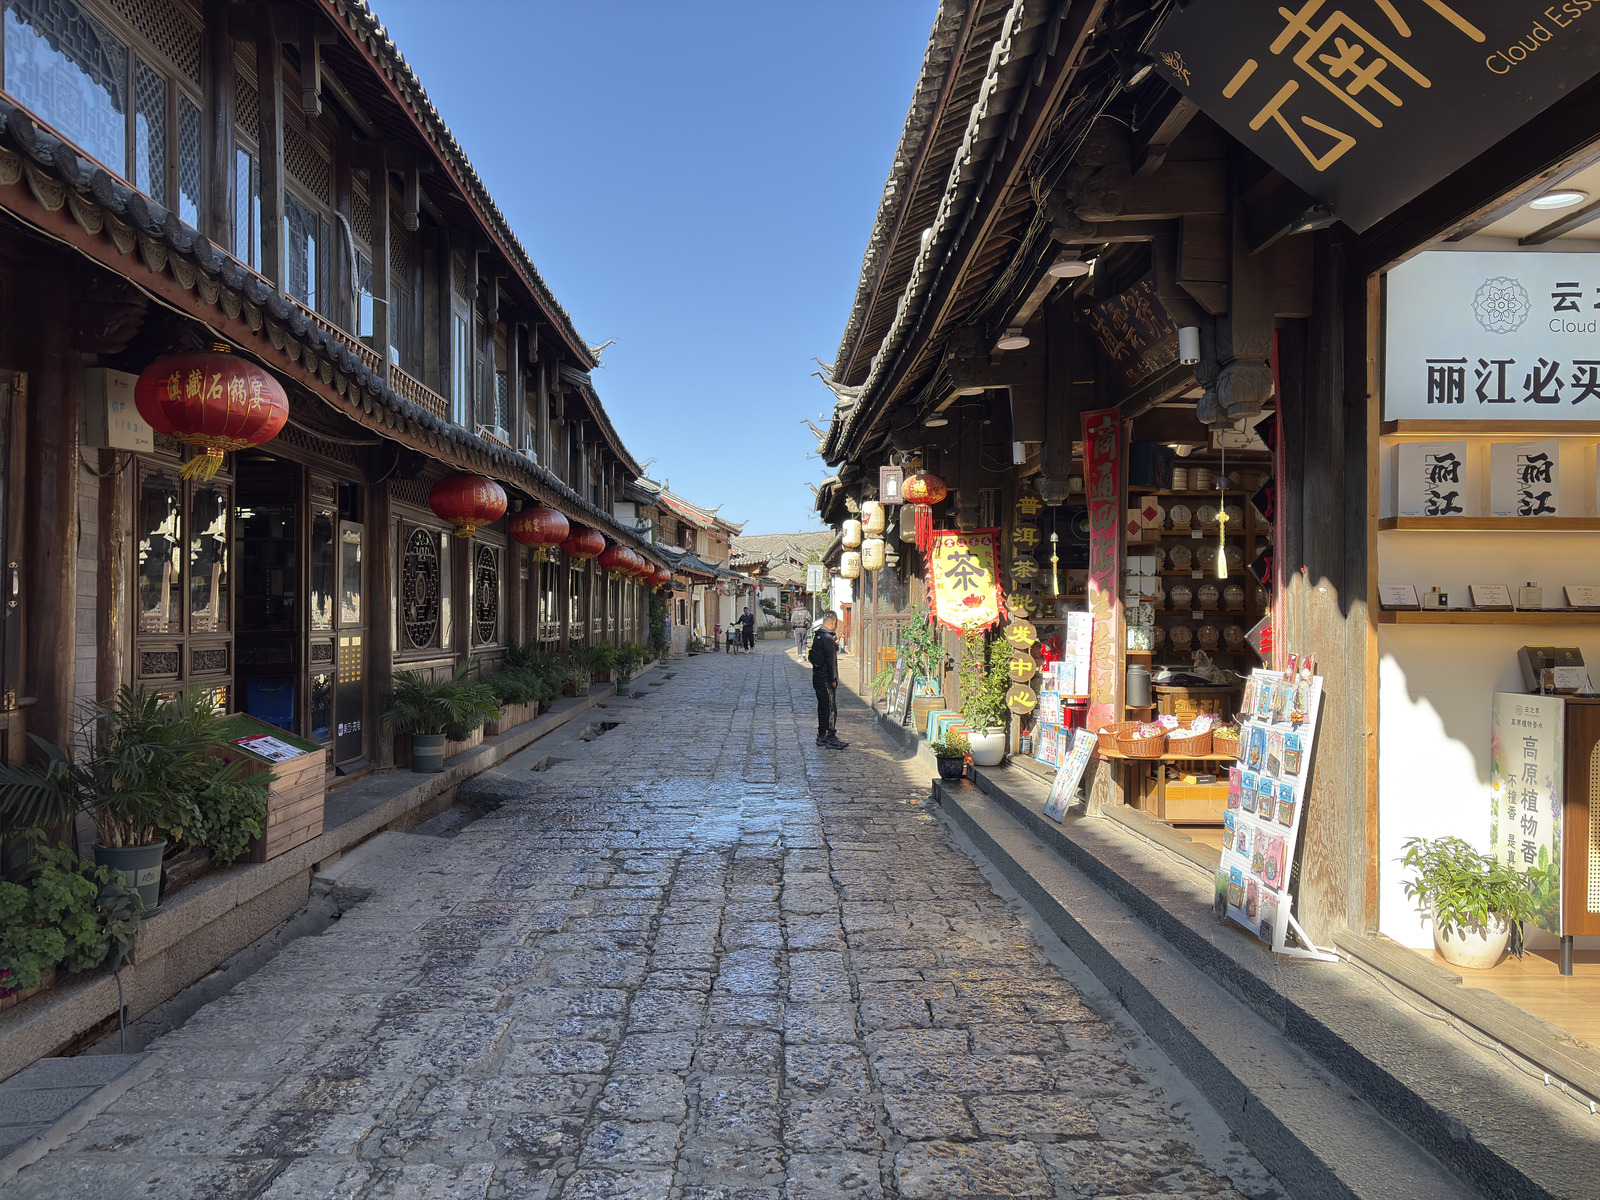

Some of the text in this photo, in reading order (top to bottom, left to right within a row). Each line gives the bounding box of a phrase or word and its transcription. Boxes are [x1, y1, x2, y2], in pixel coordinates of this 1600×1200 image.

[1485, 0, 1600, 75] Cloud Ess
[1551, 281, 1600, 313] 云
[1549, 318, 1597, 333] Cloud
[1425, 356, 1600, 405] 丽江必买
[1428, 452, 1463, 516] 丽江
[1521, 452, 1556, 516] 丽江
[944, 550, 986, 592] 茶
[1007, 495, 1043, 707] 普洱茶批发中心
